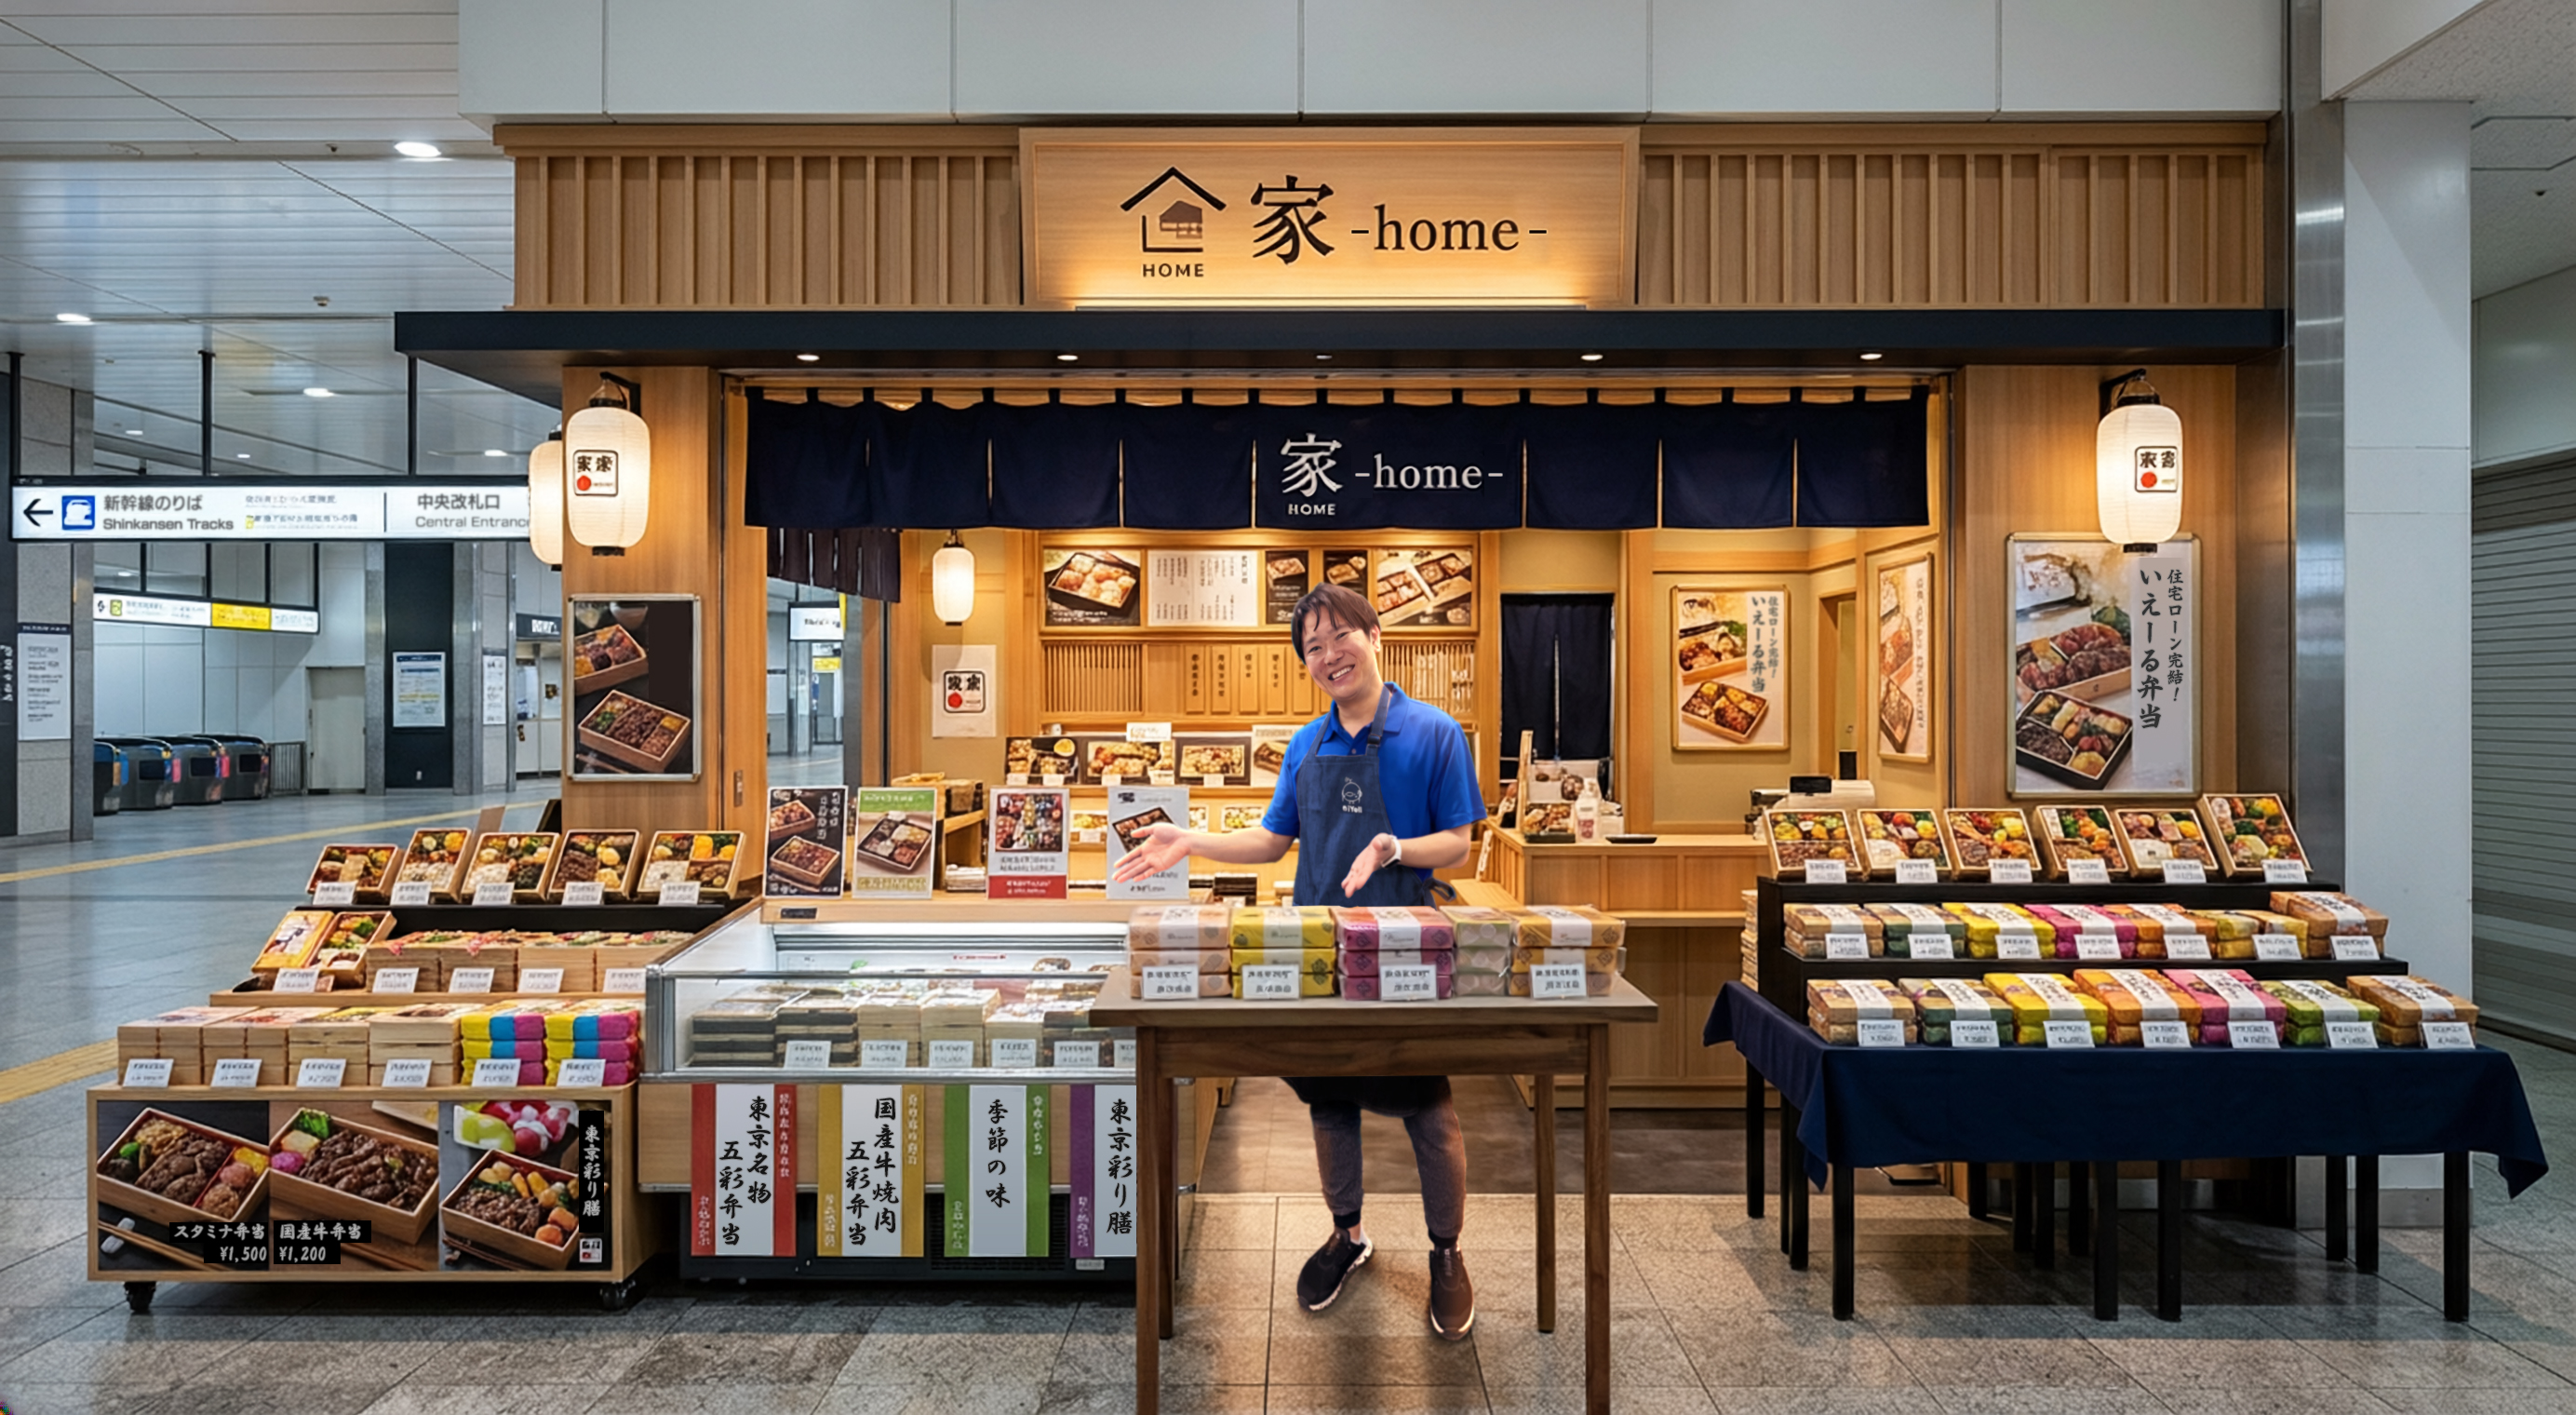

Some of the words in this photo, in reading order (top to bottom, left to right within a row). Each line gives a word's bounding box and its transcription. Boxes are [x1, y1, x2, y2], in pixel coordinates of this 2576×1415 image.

[1250, 174, 1335, 265] 家
[1142, 263, 1204, 278] HOME
[1280, 432, 1343, 498] 家
[102, 494, 204, 512] 新幹線のりば
[102, 518, 183, 531] Shinkansen
[187, 518, 235, 531] Tracks
[415, 516, 467, 529] Central
[472, 516, 530, 529] Entranc
[417, 493, 501, 511] 中央改札口
[1288, 503, 1336, 516] HOME
[1750, 596, 1766, 694] いえーる弁当
[2137, 569, 2164, 729] いえーる弁当
[583, 1124, 602, 1218] 東京彩り膳
[746, 1096, 771, 1205] 東京名物
[872, 1097, 900, 1234] 国産牛焼肉
[985, 1098, 1011, 1208] 季節の味
[1106, 1098, 1134, 1235] 東京彩り膳
[718, 1141, 745, 1247] 五彩弁当
[845, 1141, 871, 1247] 五彩弁当
[173, 1222, 266, 1242] スタミナ弁当
[220, 1246, 267, 1263] ¥1,500
[279, 1222, 362, 1242] 国産牛弁当
[279, 1246, 327, 1263] ¥1,200
